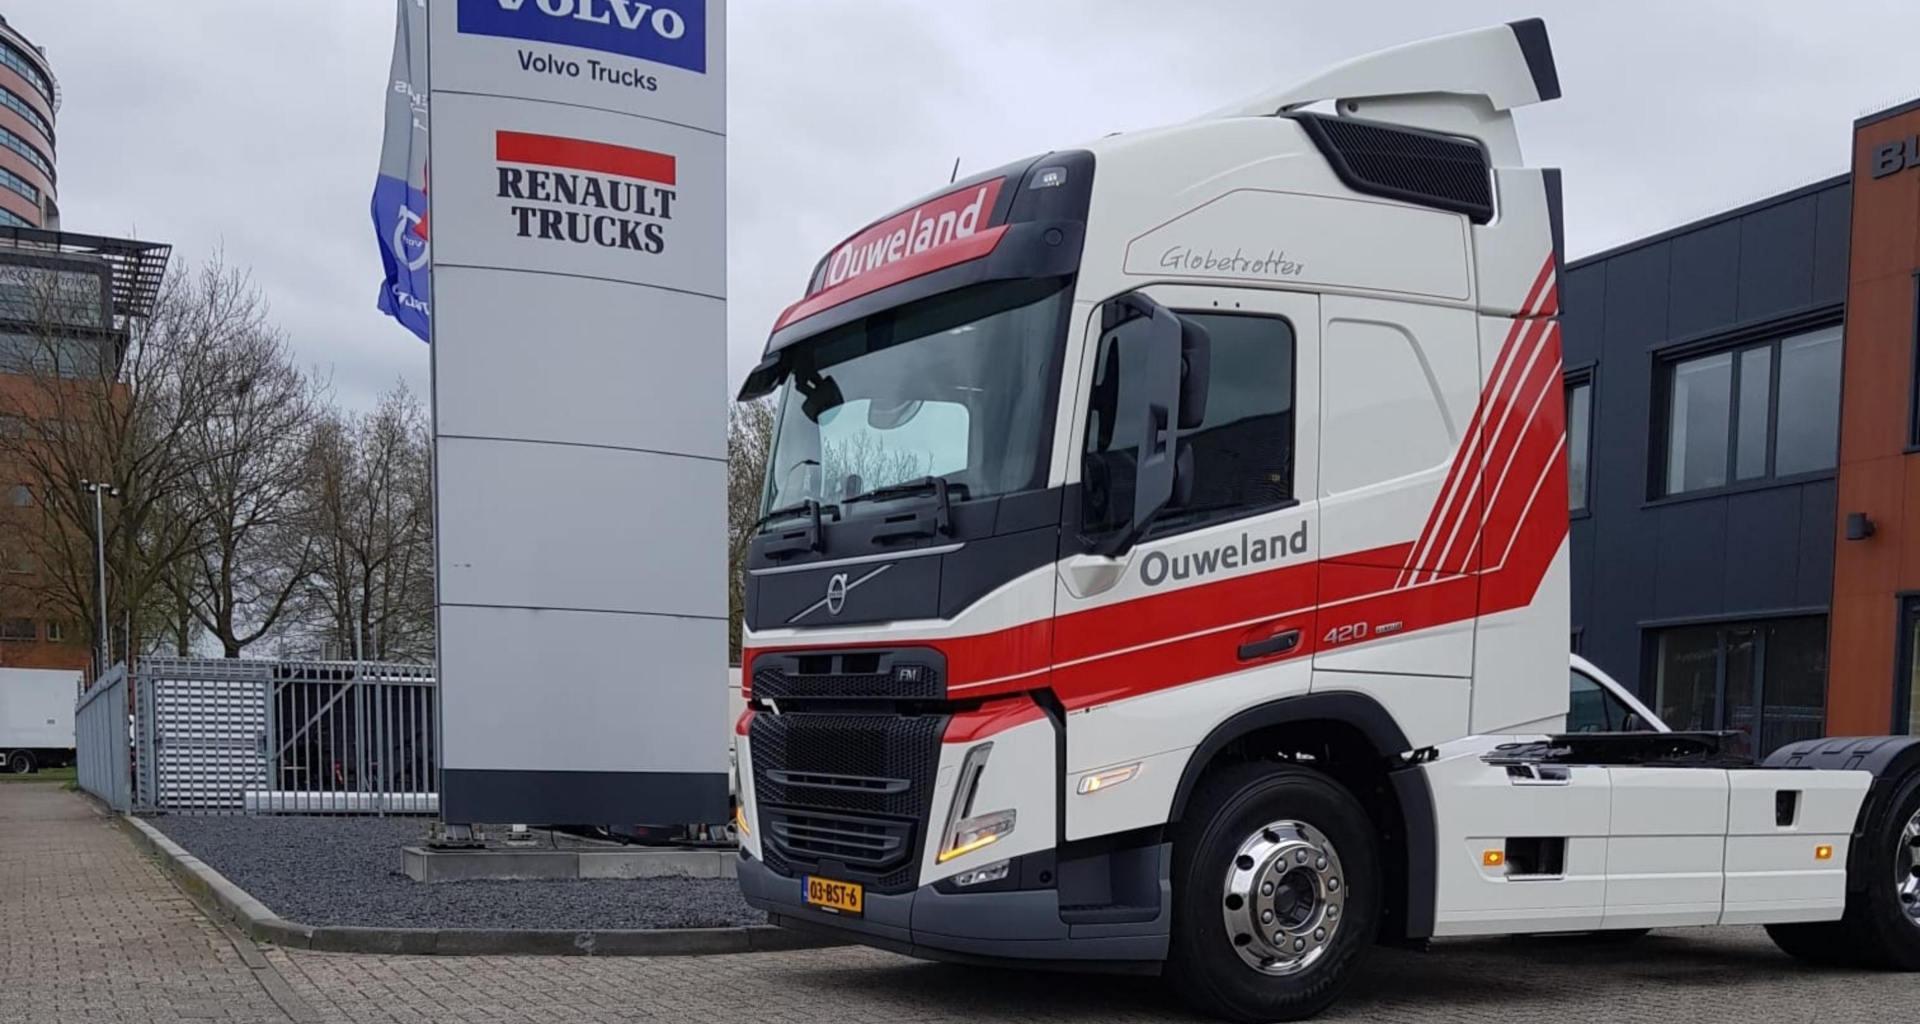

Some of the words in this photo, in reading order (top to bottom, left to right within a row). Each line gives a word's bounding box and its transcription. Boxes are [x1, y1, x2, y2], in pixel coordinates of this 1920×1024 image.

[518, 49, 580, 77] Volvo
[587, 59, 658, 92] Trucks
[496, 167, 676, 220] RENAULT
[511, 206, 665, 254] TRUCKS
[829, 187, 987, 287] Ouweland
[1160, 245, 1306, 276] Globetrotter
[1139, 519, 1309, 586] Ouweland
[1323, 621, 1368, 643] 420
[899, 668, 917, 682] FM
[810, 880, 858, 907] 03-BST-6
